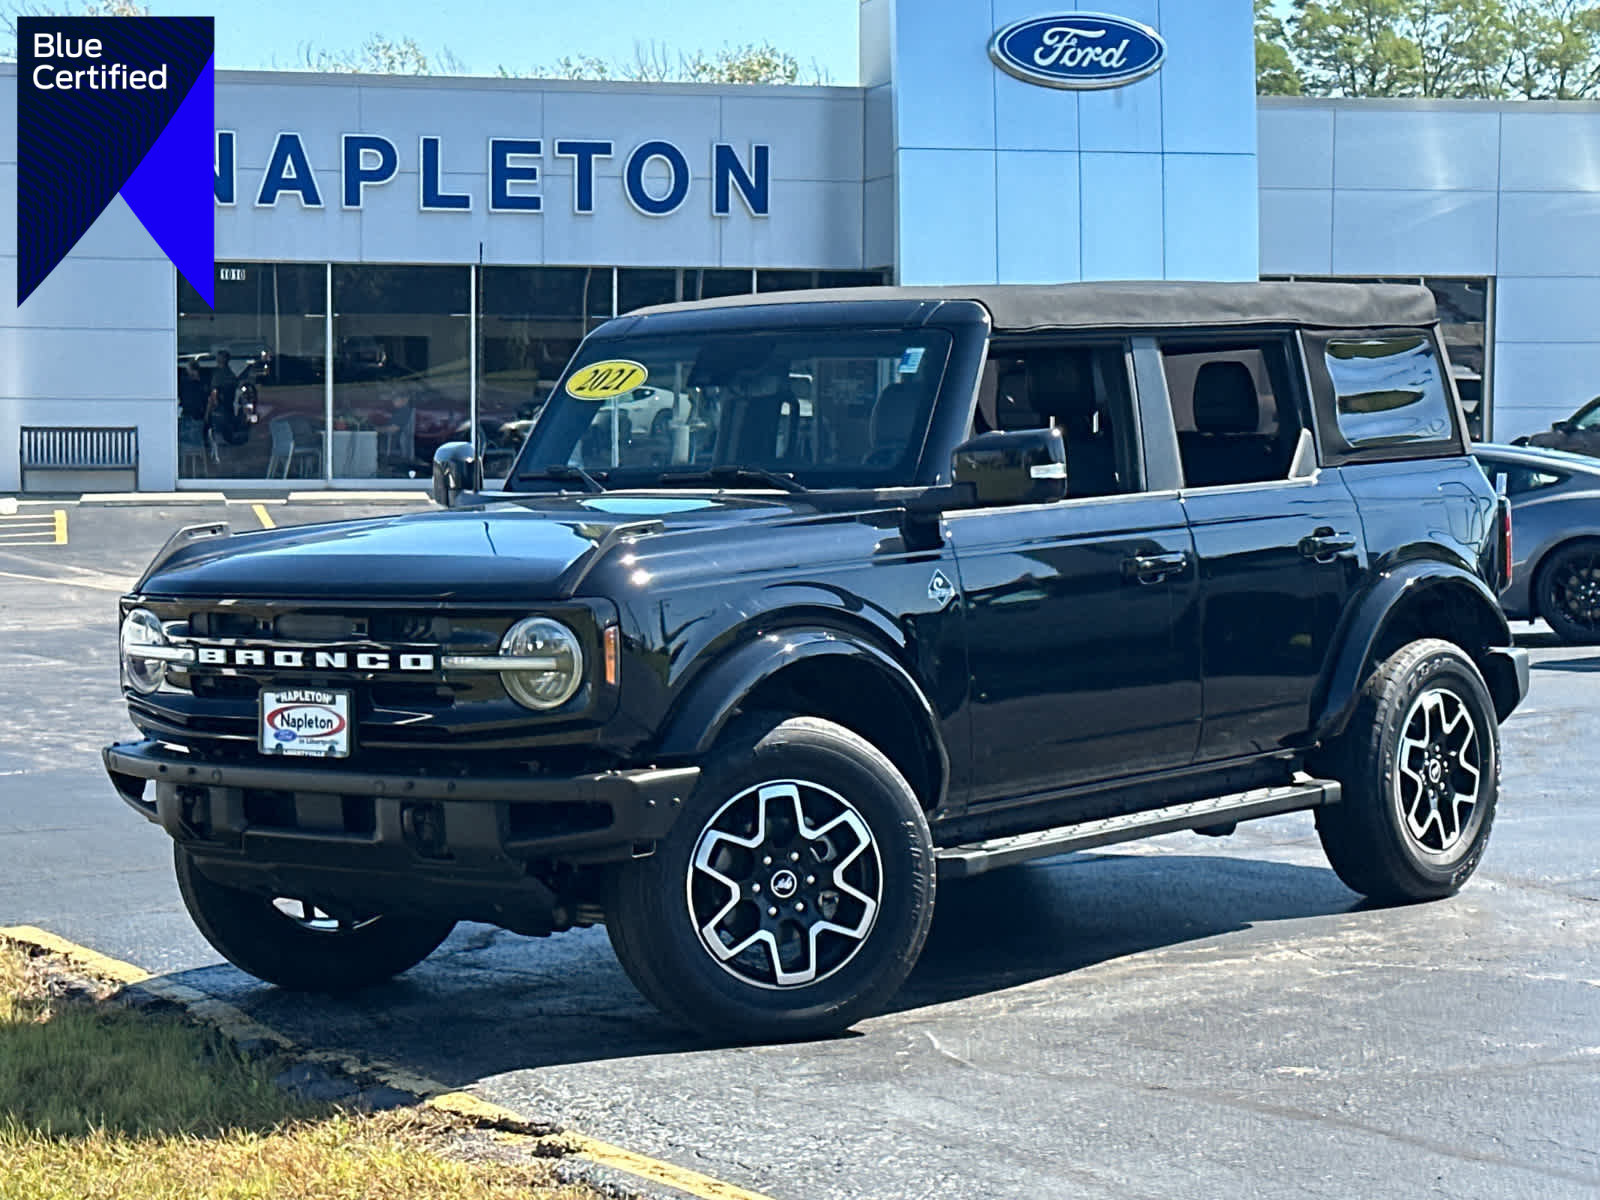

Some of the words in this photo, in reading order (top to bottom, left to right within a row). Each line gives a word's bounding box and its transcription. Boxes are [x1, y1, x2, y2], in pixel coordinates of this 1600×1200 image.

[1034, 27, 1130, 68] Ford
[220, 268, 246, 281] 1010
[576, 369, 637, 391] 2021
[198, 647, 434, 671] BRONCO
[281, 711, 333, 732] Napleton
